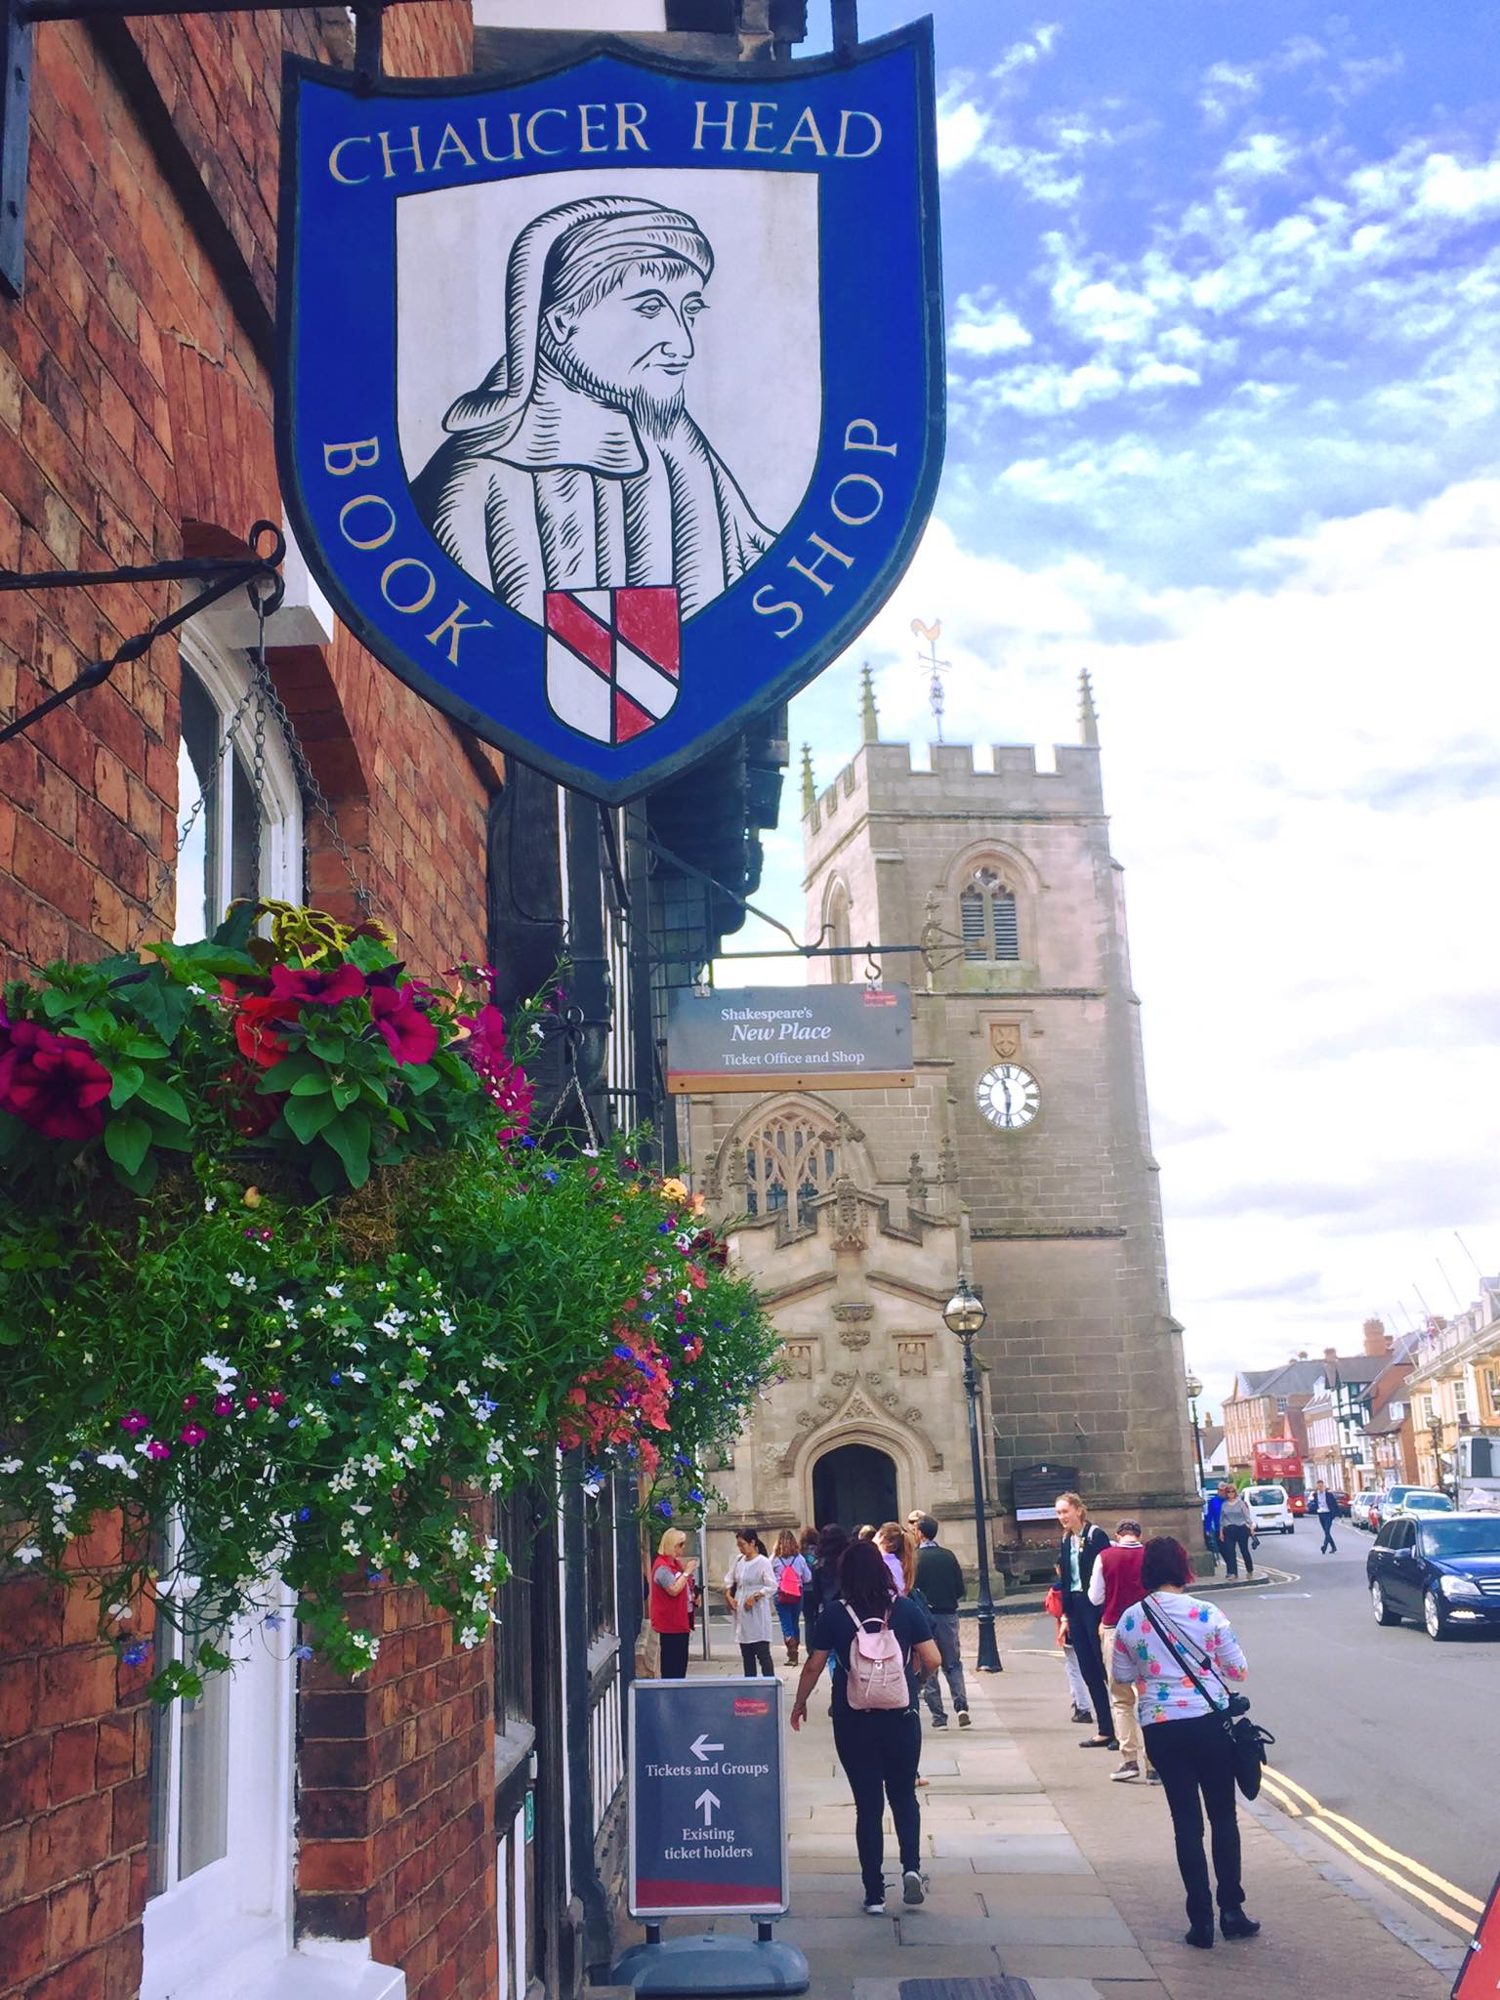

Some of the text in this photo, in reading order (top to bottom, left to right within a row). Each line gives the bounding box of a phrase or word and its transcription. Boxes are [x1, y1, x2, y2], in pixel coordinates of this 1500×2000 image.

[329, 101, 882, 185] CHAUCER HEAD
[752, 417, 898, 639] SHOP
[323, 437, 493, 665] BOOK
[721, 1007, 813, 1024] Shakespeare's
[730, 1022, 832, 1041] New Place
[722, 1050, 865, 1066] Ticket Office and Shop
[645, 1762, 769, 1778] Tickets and Groups
[682, 1828, 735, 1843] Existing
[664, 1845, 753, 1860] ticket holders
